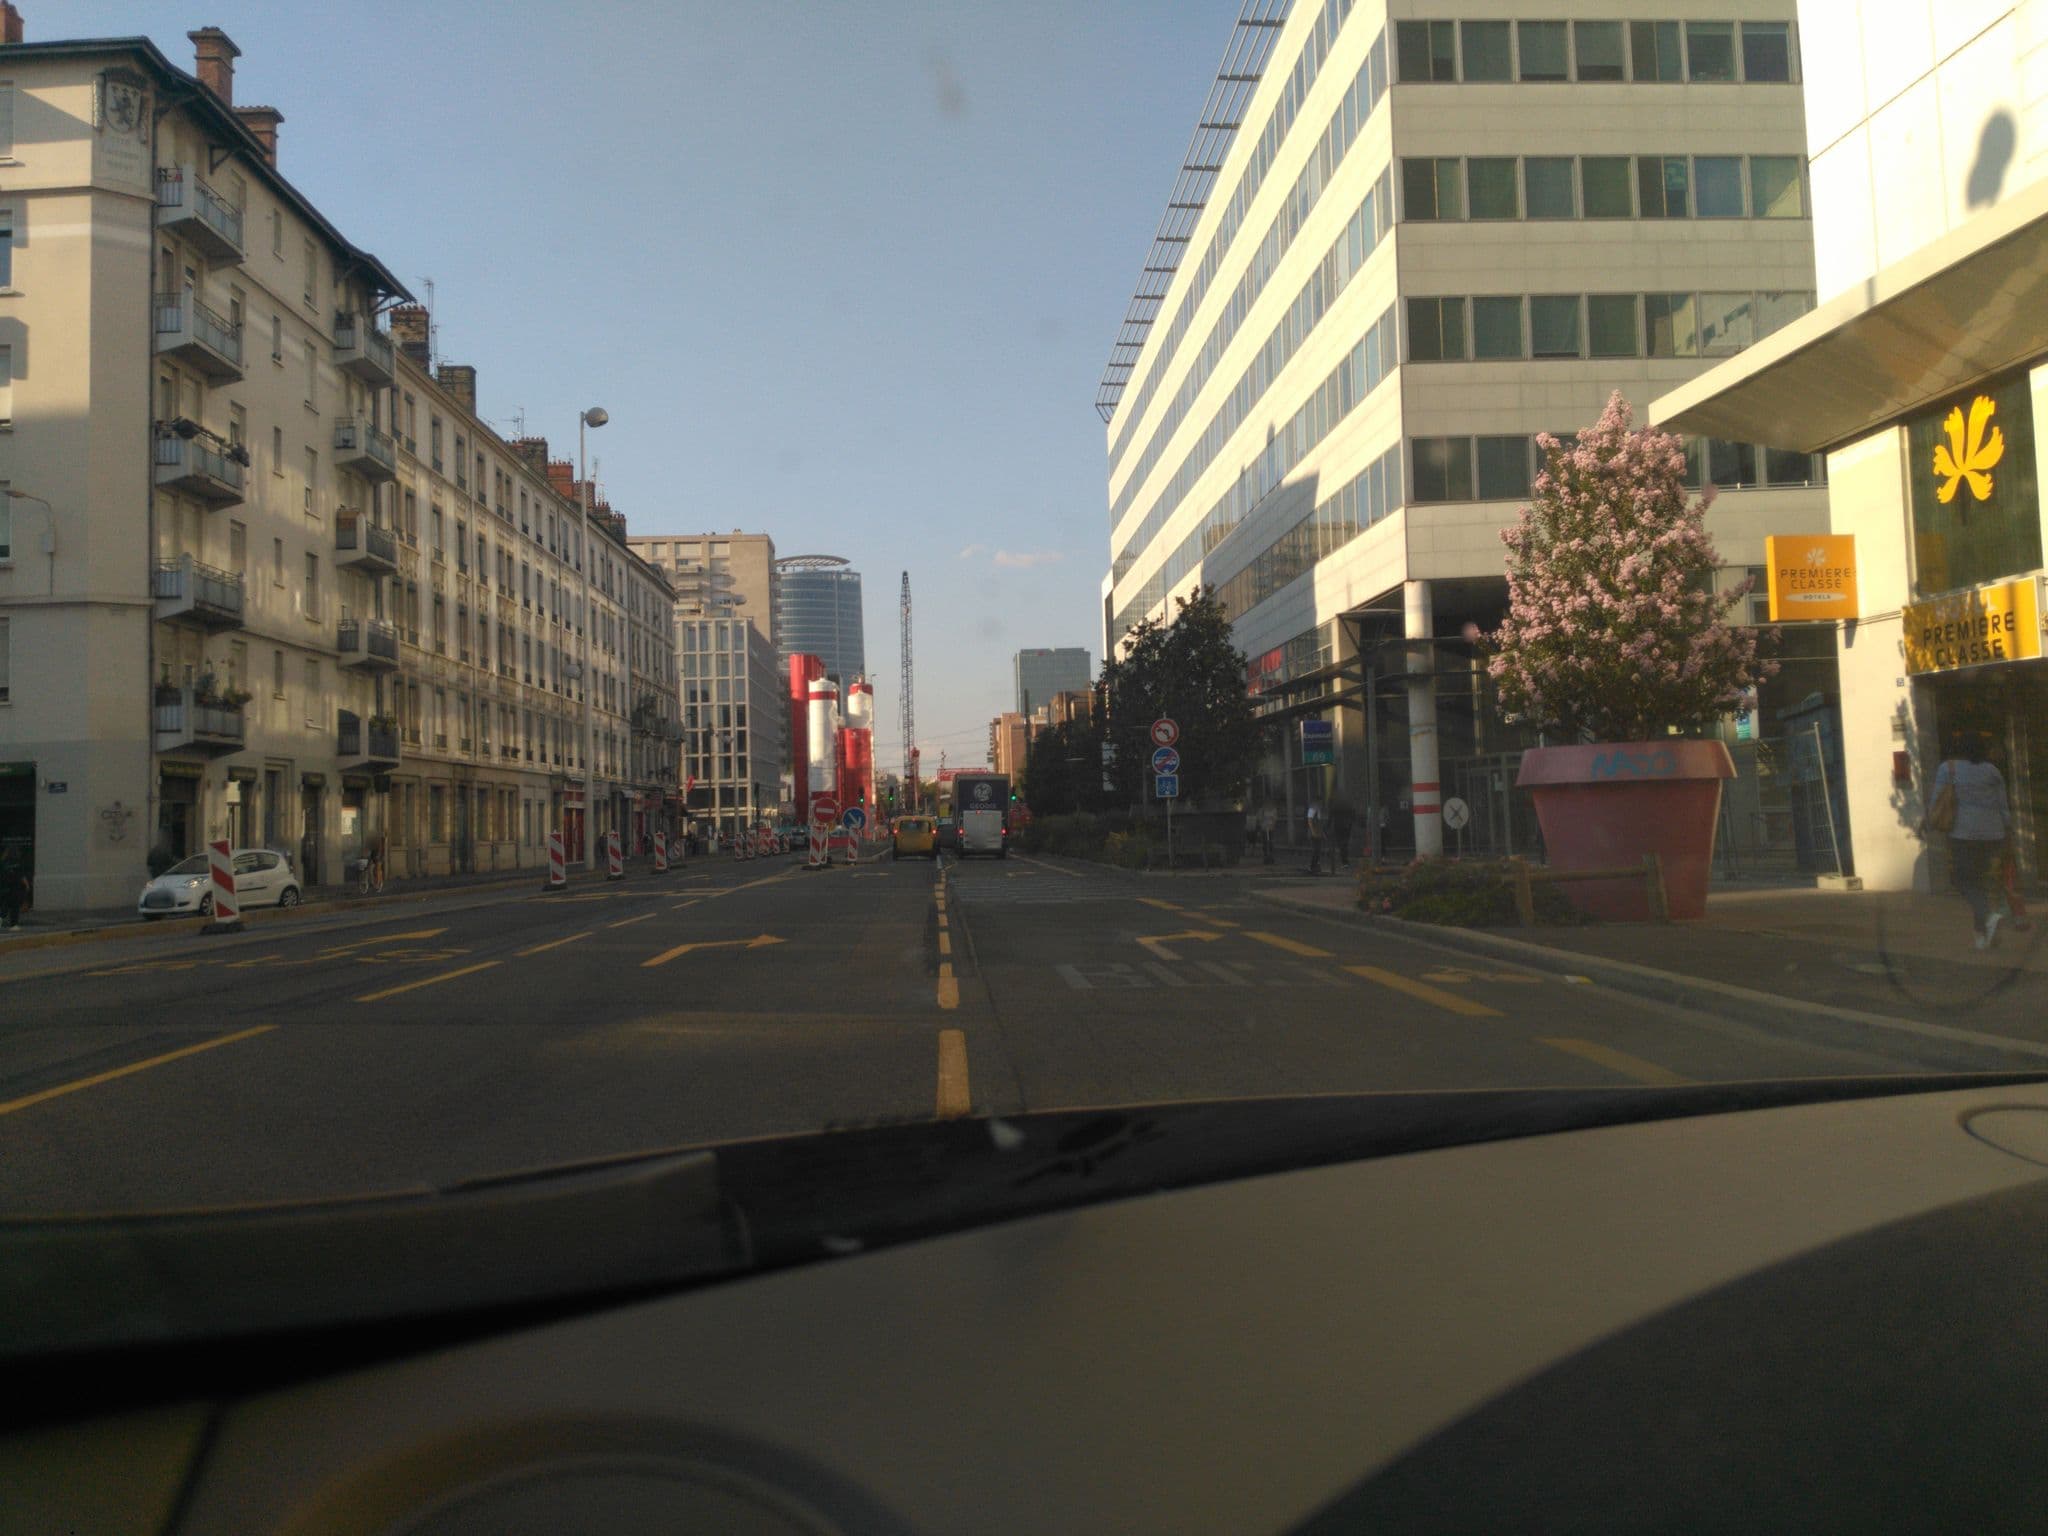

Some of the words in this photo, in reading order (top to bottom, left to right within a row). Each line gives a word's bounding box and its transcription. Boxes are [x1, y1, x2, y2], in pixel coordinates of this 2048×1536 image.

[1780, 568, 1851, 579] PREMIERE
[1791, 579, 1842, 589] CLASSE
[1923, 611, 2015, 647] PREMIERE
[1934, 638, 2004, 667] CLASSE
